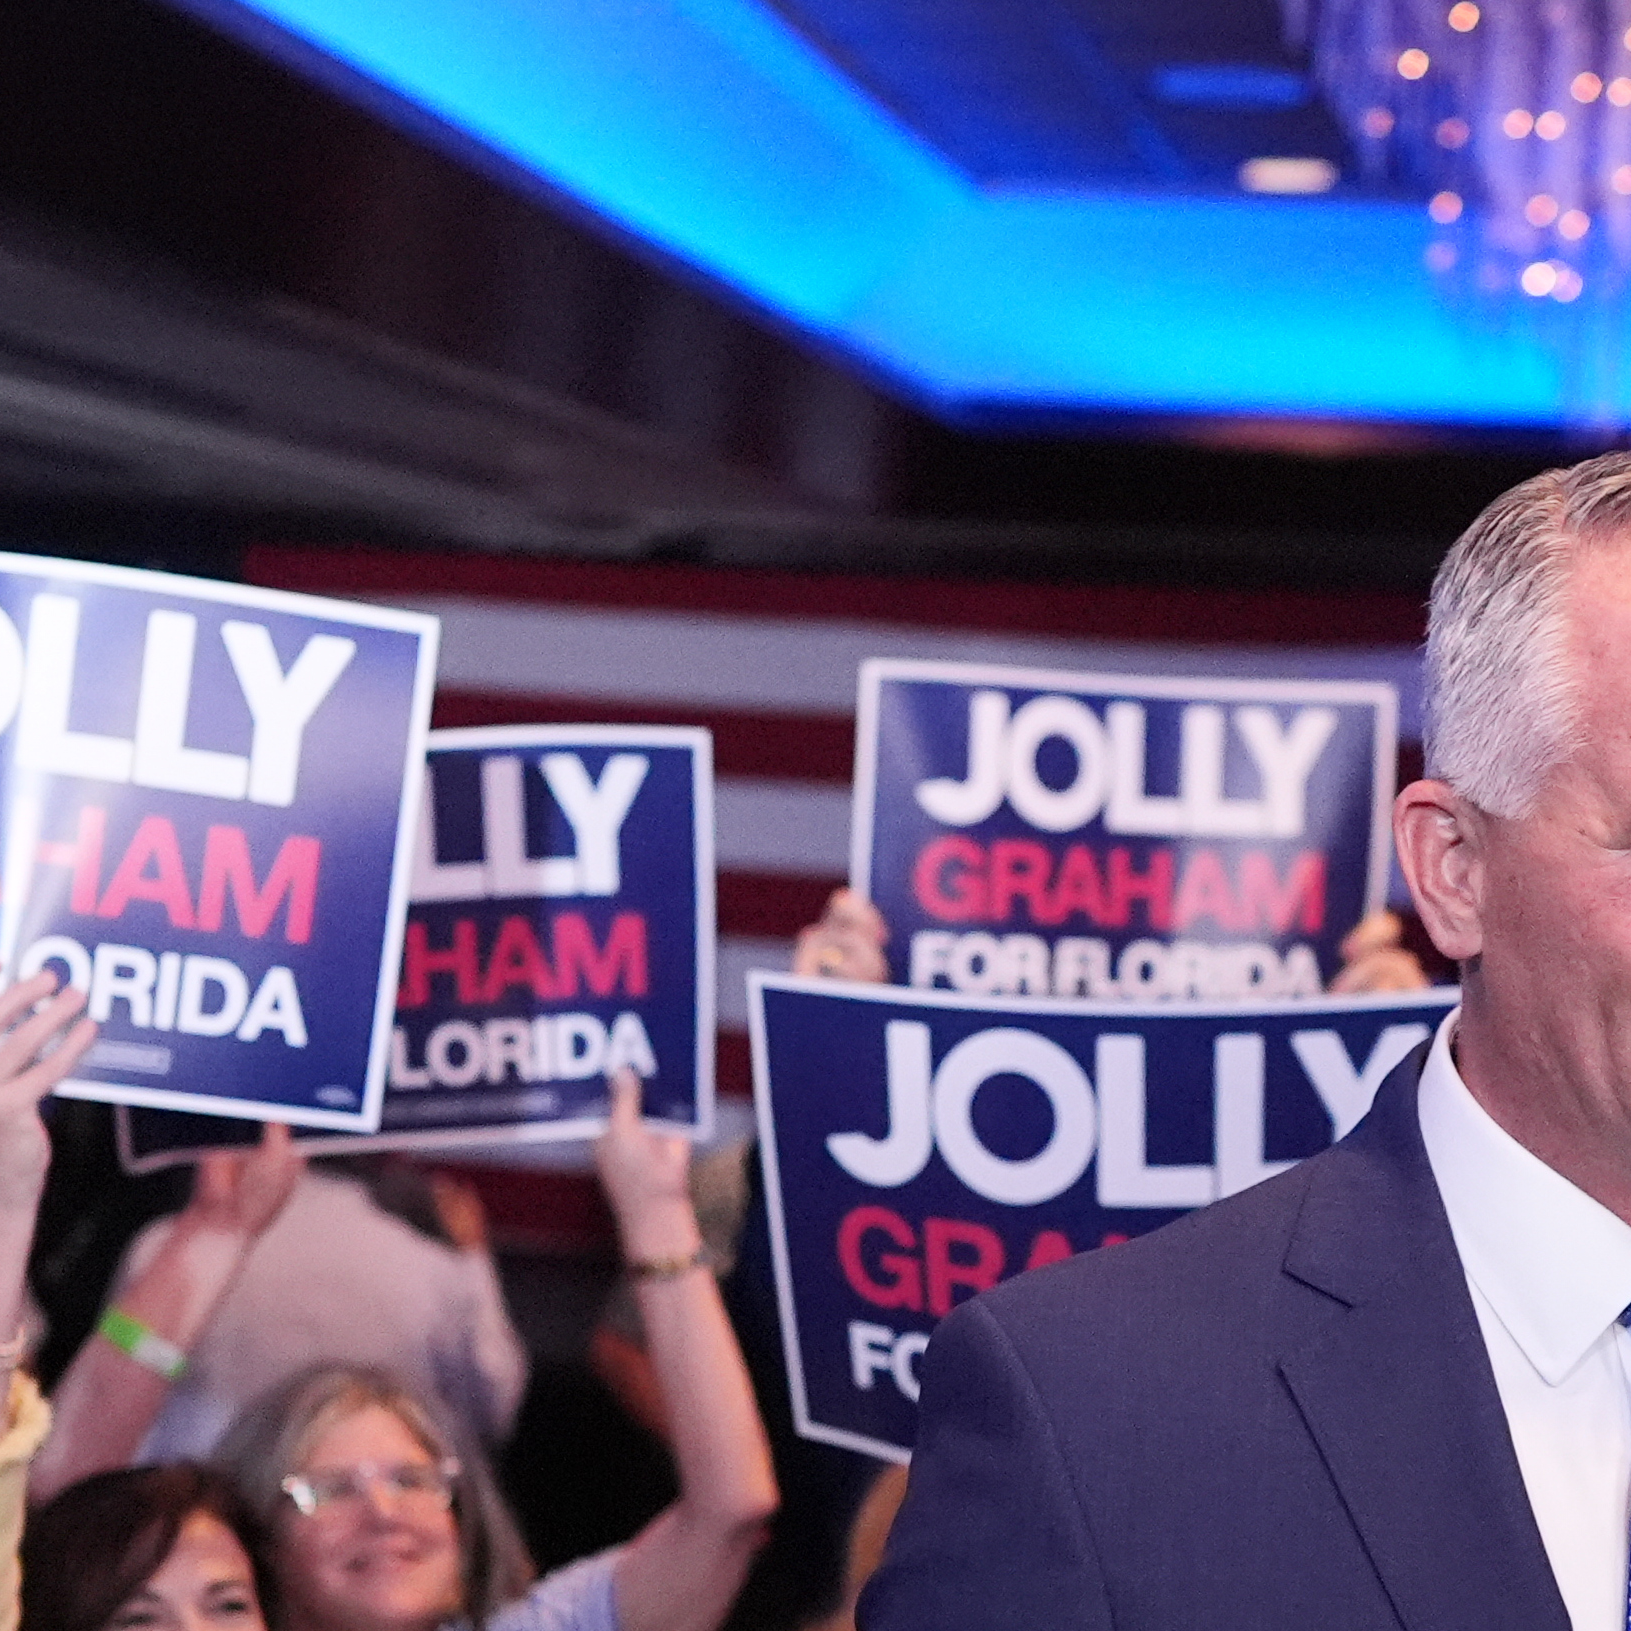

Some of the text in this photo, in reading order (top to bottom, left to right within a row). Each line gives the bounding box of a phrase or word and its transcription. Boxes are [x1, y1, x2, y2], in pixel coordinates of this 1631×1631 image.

[916, 690, 1338, 838] JOLLY
[407, 752, 651, 902] LLY
[912, 838, 1328, 934] GRAHAM
[396, 911, 648, 1009] HAM
[910, 931, 1324, 998] FOR FLORIDA
[387, 1011, 657, 1091] LORIDA
[826, 1019, 1430, 1210] JOLLY
